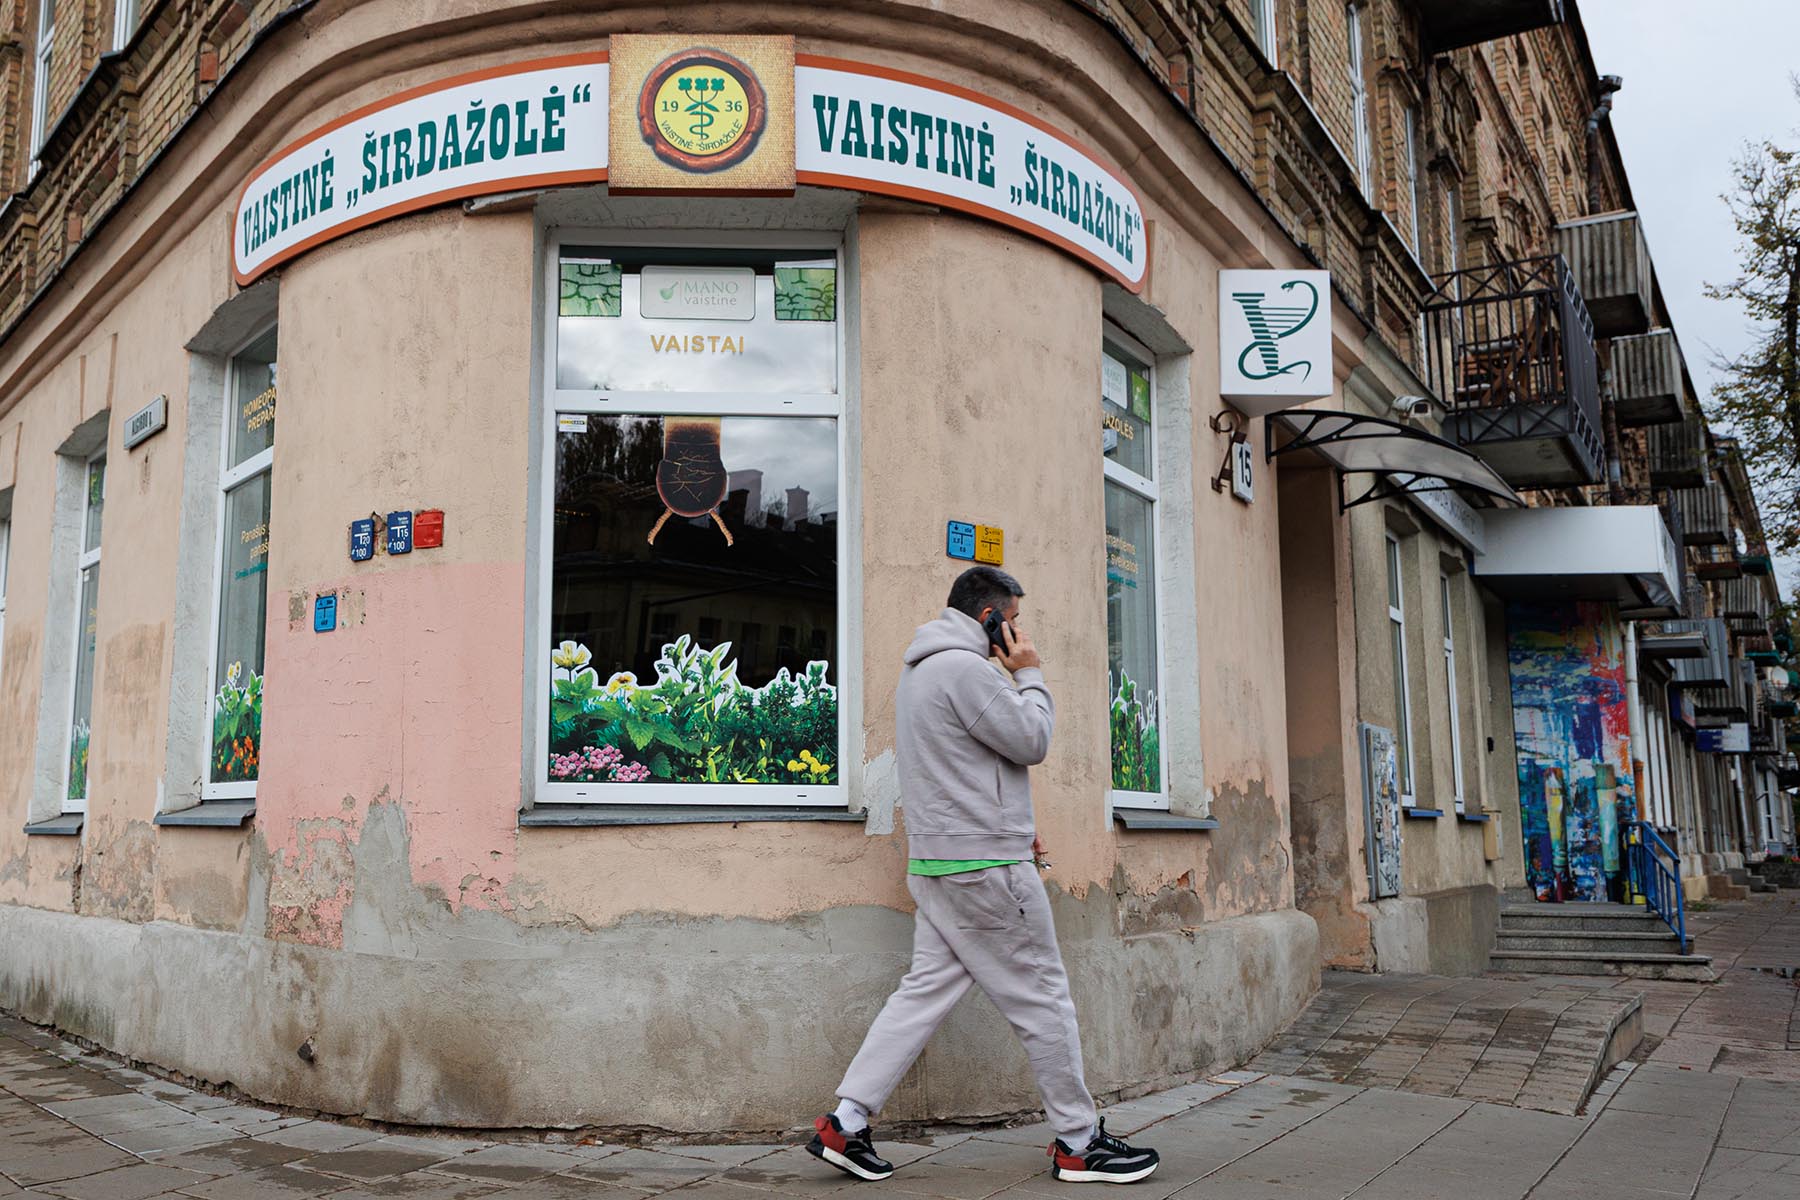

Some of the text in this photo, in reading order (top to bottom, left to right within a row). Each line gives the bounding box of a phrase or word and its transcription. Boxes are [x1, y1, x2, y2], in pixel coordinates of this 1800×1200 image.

[661, 100, 743, 112] 19 36
[660, 119, 693, 149] VAISTINĖ
[813, 94, 996, 189] VAISTINĖ
[243, 149, 335, 257] VAISTINĖ
[684, 280, 739, 294] MANO
[650, 335, 745, 353] VAISTAI
[1239, 447, 1252, 488] 15
